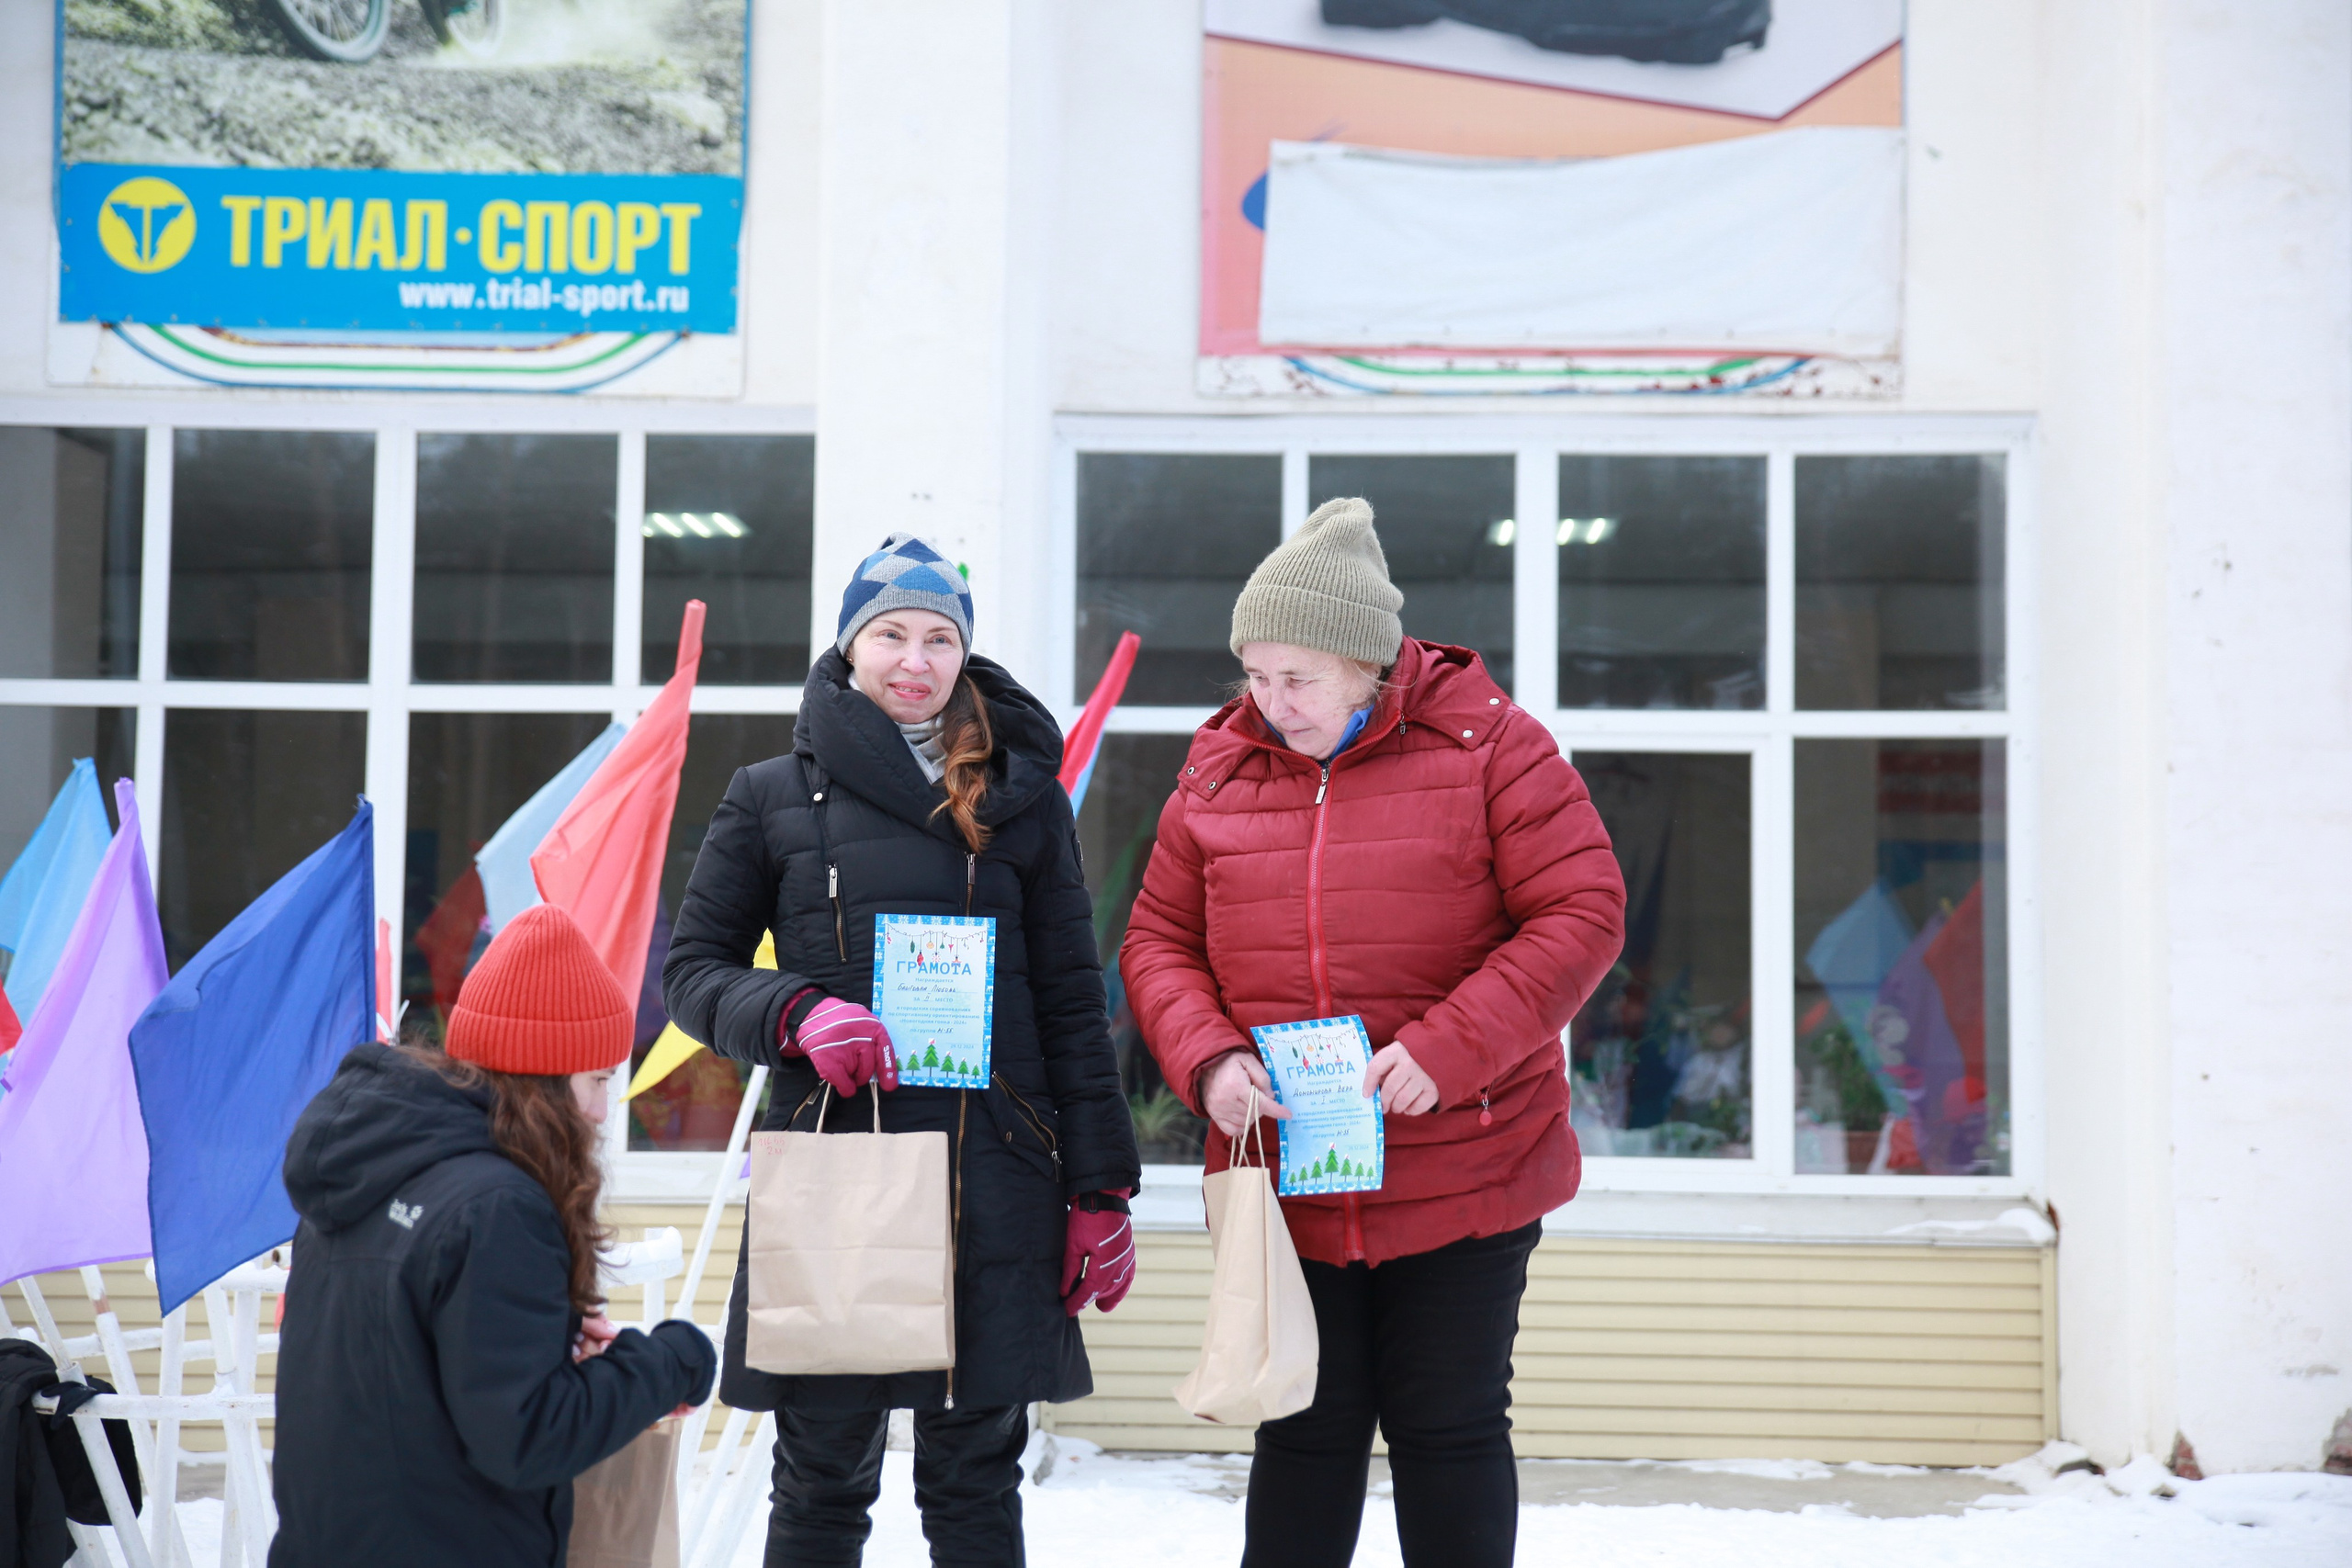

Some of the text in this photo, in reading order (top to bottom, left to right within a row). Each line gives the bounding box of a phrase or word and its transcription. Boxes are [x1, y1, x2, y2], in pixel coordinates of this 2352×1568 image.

[398, 277, 690, 318] www.trial-sport.ru
[897, 961, 972, 976] ГРАМОТА
[1286, 1061, 1356, 1079] ГРАМОТА
